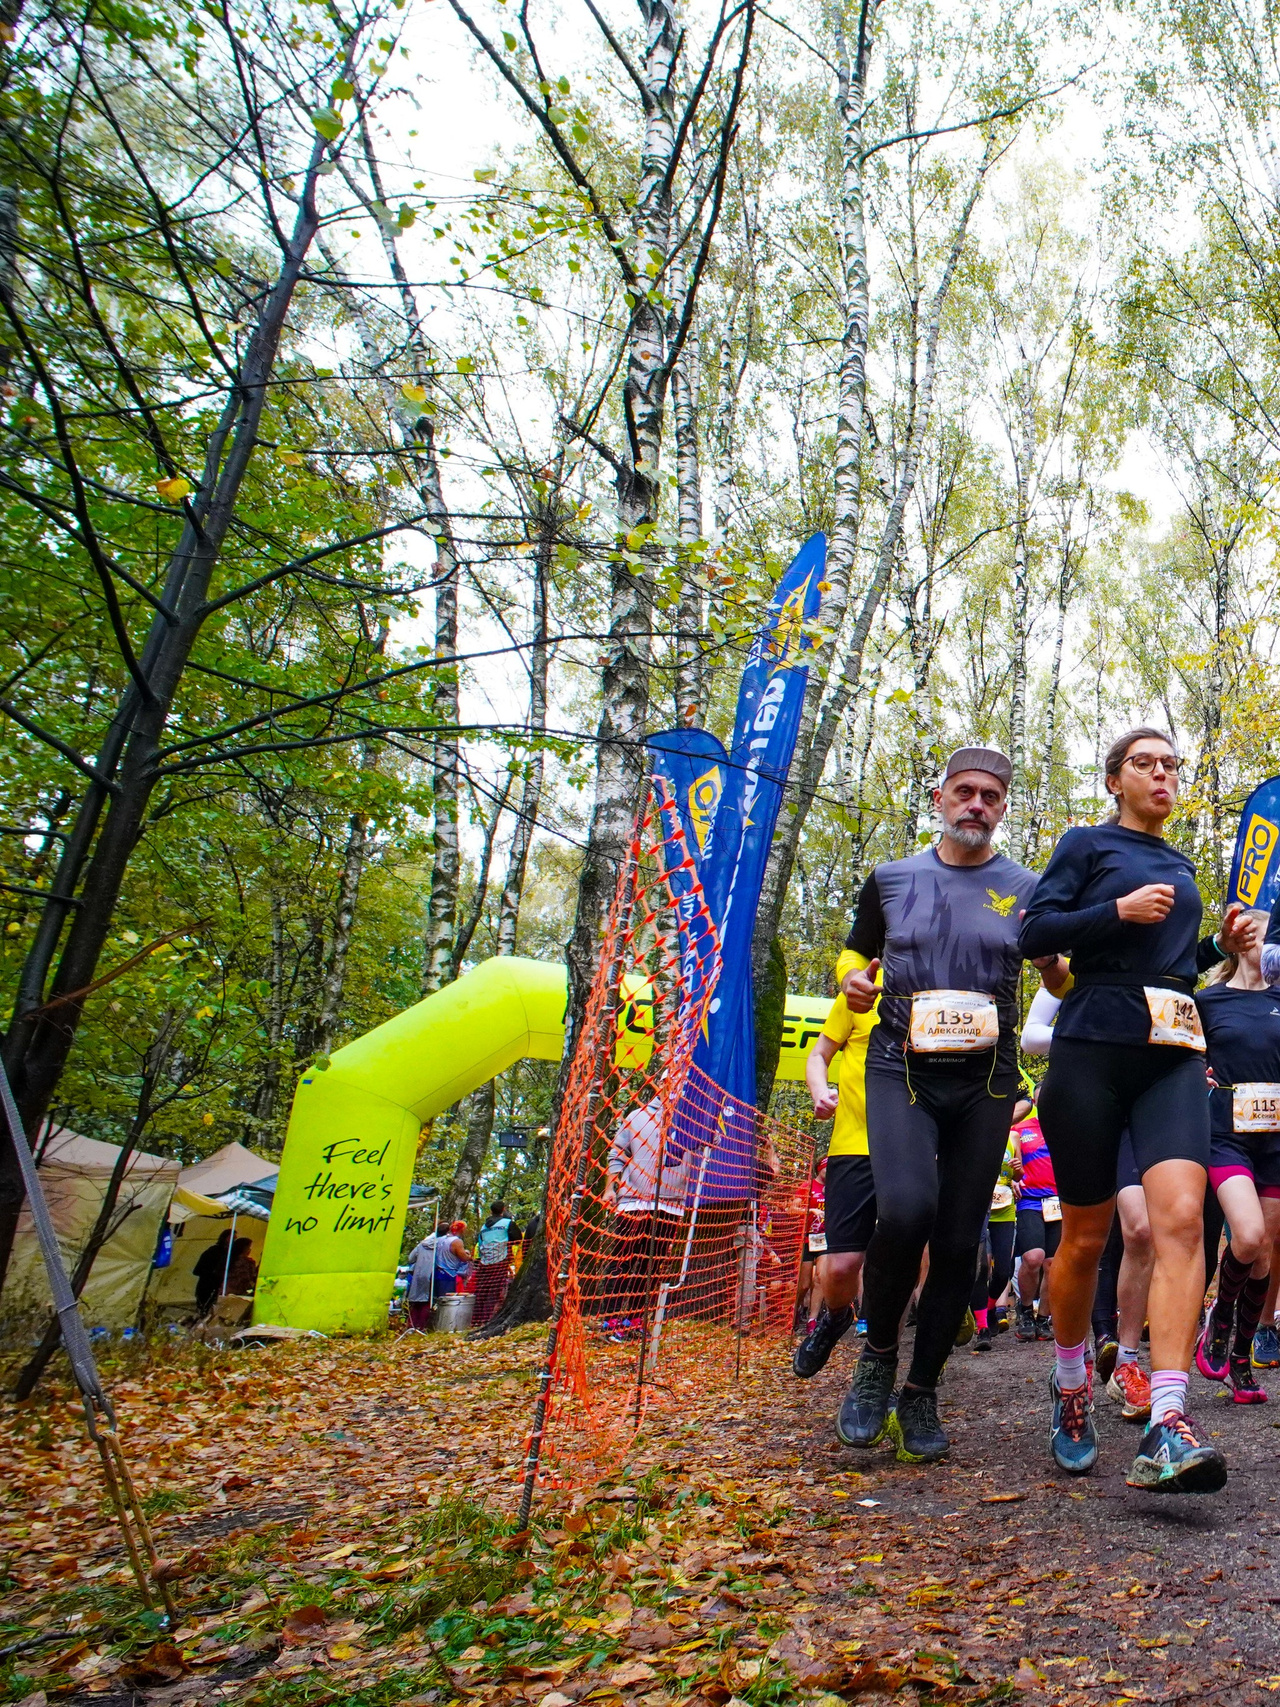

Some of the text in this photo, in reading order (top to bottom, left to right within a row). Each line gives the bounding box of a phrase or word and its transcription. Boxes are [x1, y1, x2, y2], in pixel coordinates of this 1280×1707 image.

[1239, 823, 1271, 899] PRO
[927, 1027, 981, 1036] Александр
[937, 1010, 974, 1025] 139
[1252, 1099, 1276, 1112] 115
[322, 1138, 392, 1166] Feel
[304, 1172, 393, 1200] there's
[284, 1203, 395, 1235] no limit
